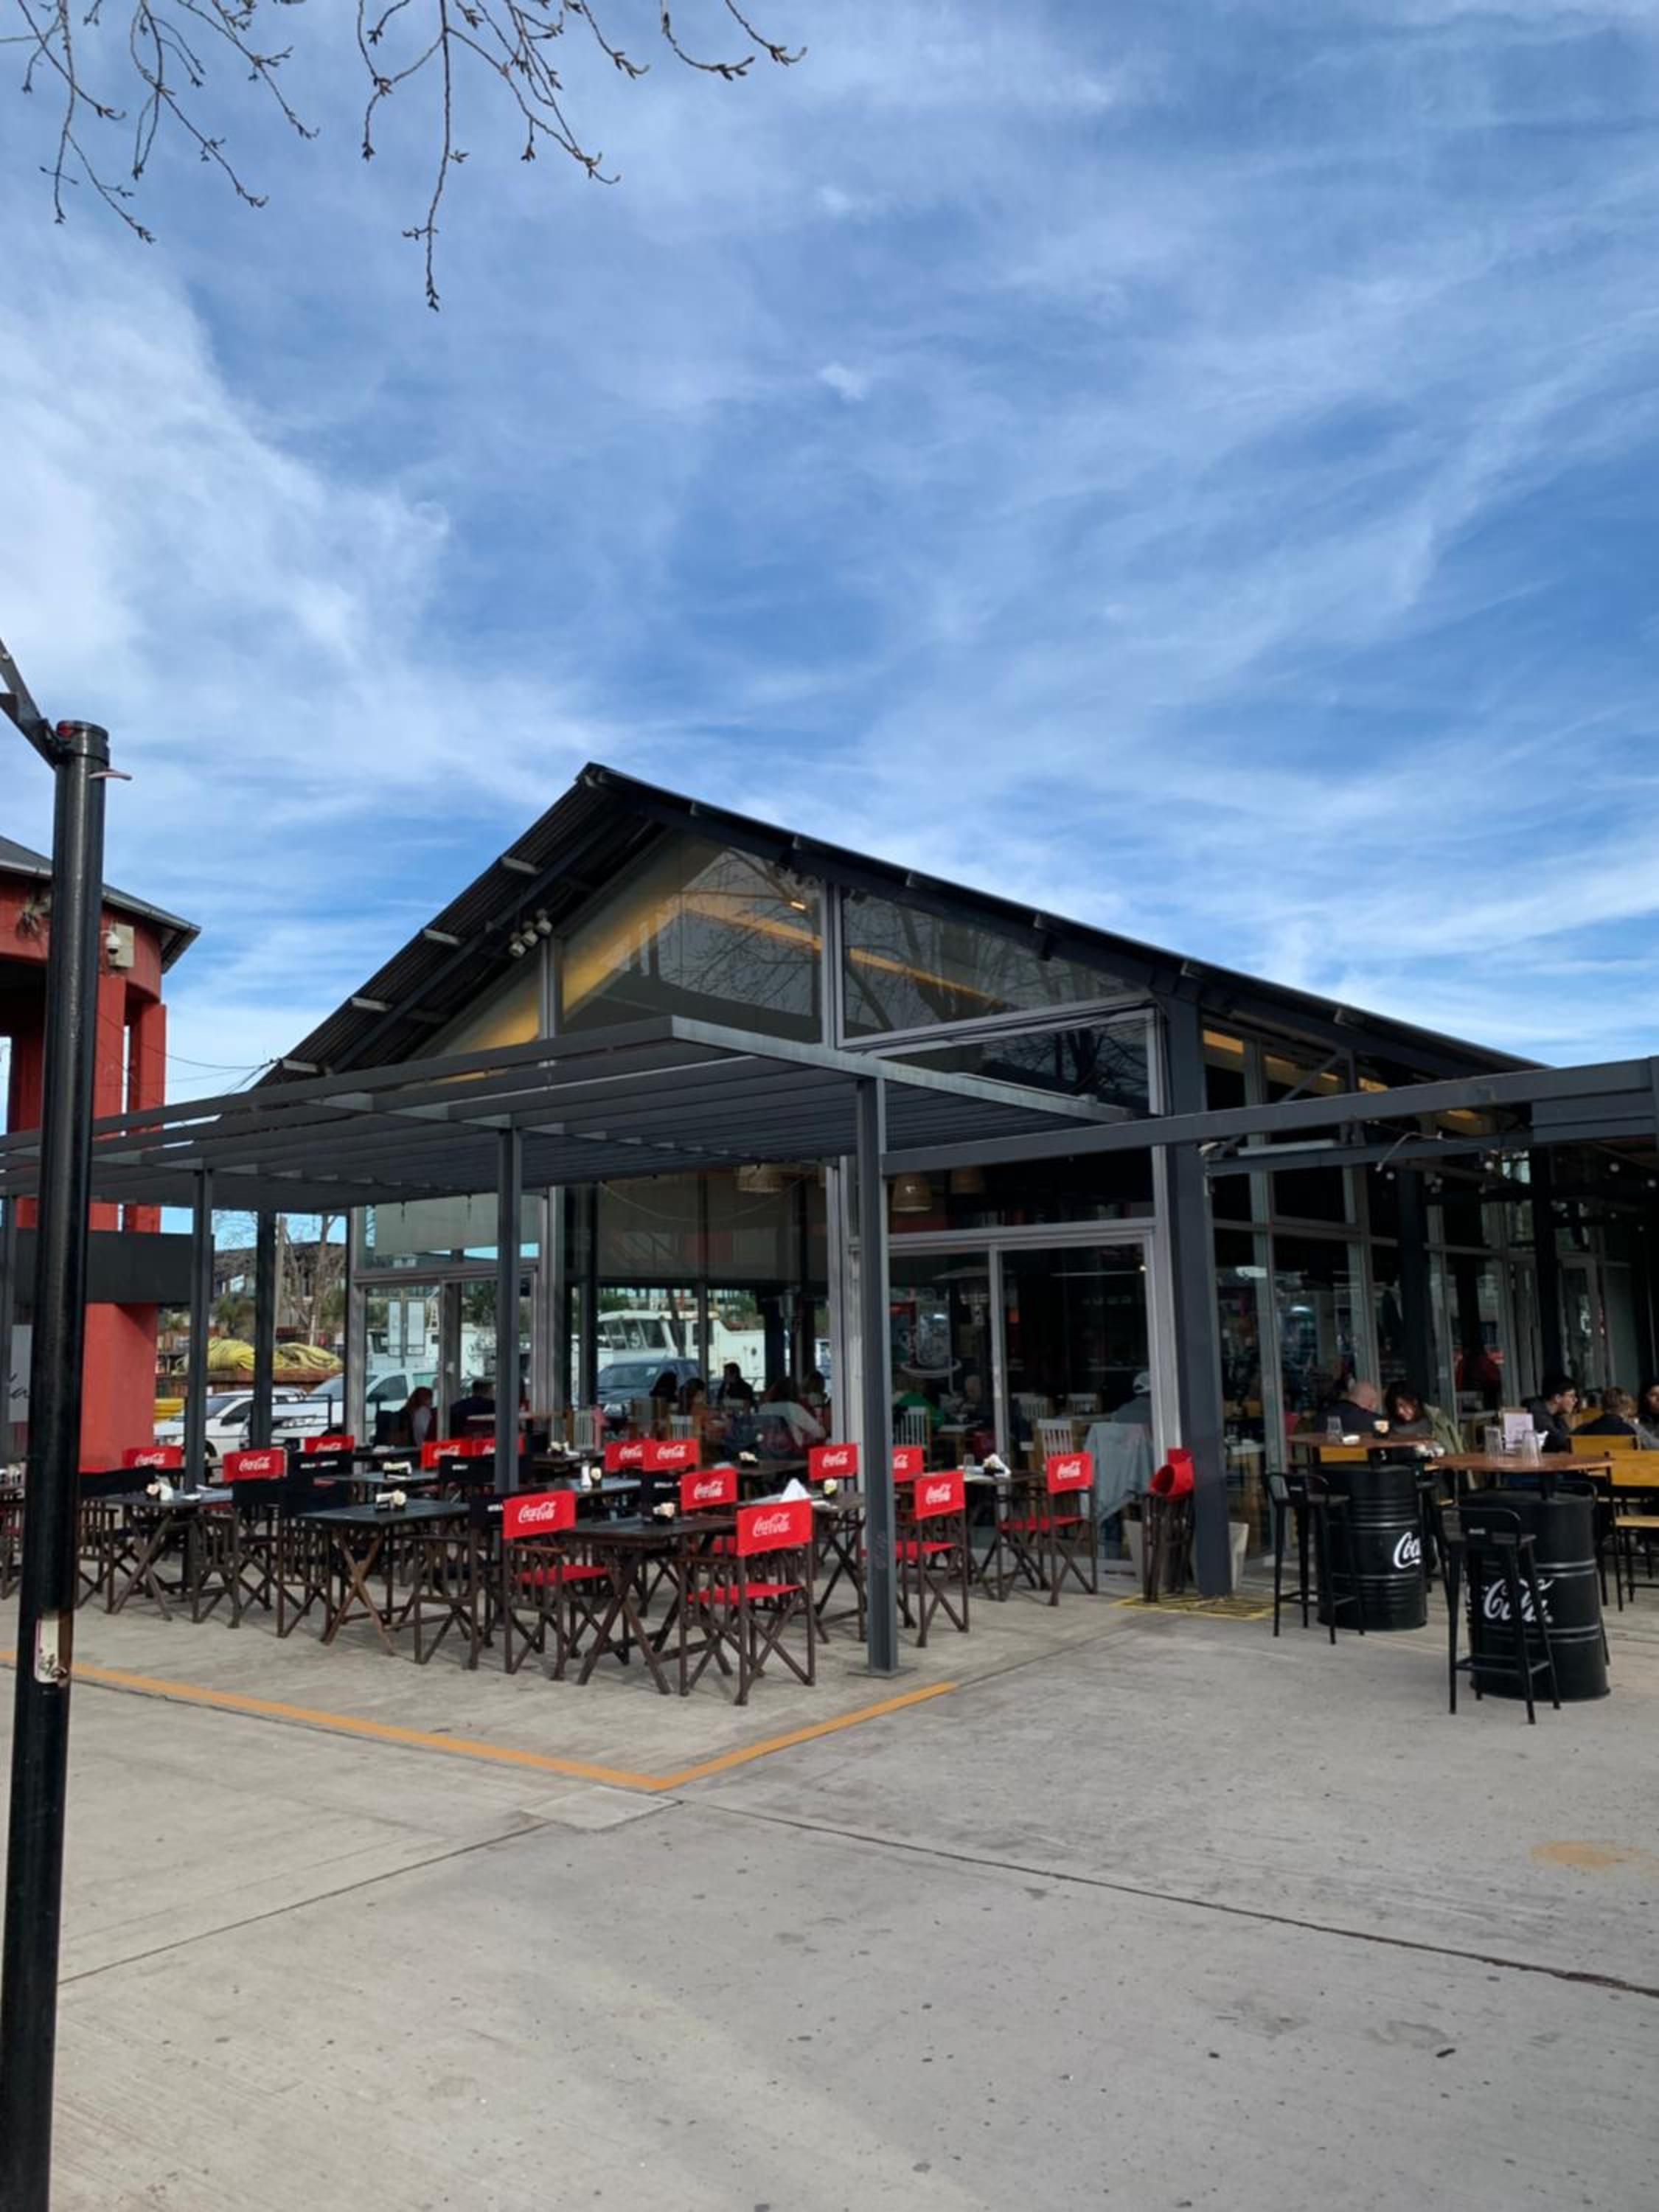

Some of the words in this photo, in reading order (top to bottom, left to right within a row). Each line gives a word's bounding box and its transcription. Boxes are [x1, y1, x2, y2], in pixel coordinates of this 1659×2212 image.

[238, 1456, 271, 1472] Coca-Cola
[694, 1479, 723, 1499] Coca-Cola
[518, 1500, 556, 1524] Coca-Cola
[752, 1512, 790, 1537] Coca-Cola
